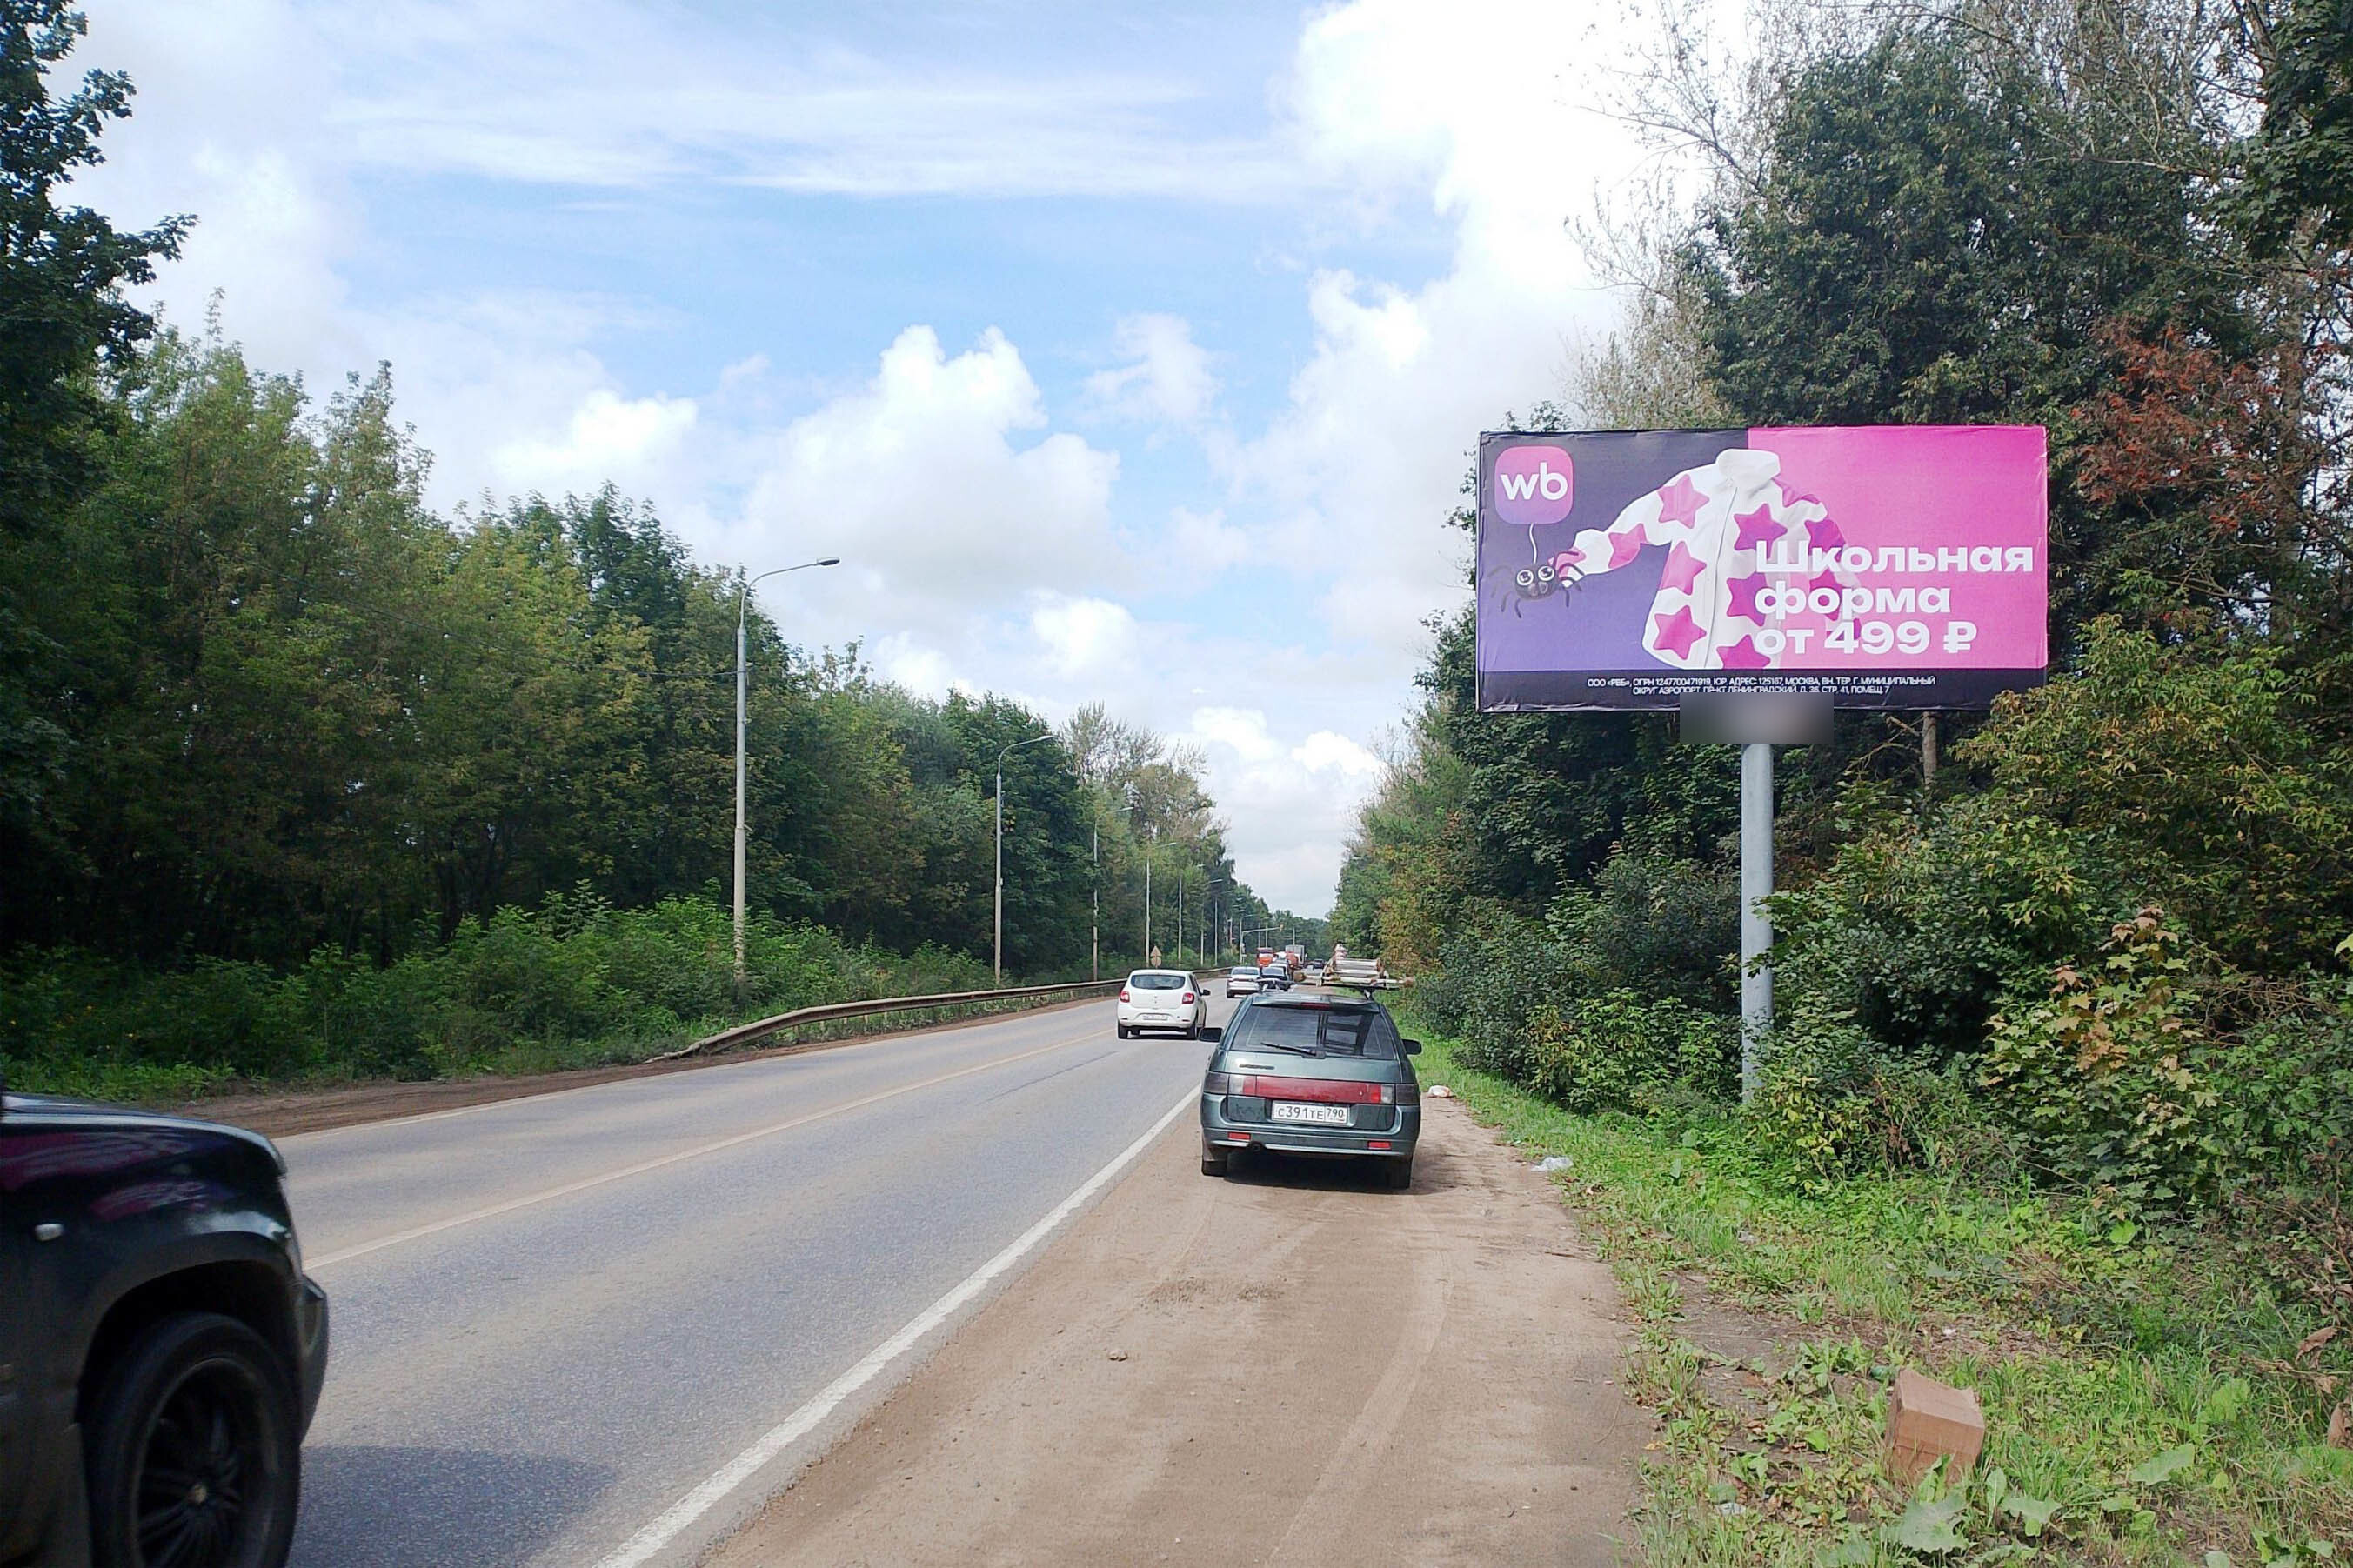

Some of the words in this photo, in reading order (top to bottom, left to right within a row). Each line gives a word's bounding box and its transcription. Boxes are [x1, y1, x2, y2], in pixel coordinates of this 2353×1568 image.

[1501, 462, 1568, 500] wb
[1755, 540, 2033, 572] Школьная
[1755, 580, 1950, 620] форма
[1755, 628, 1814, 654] от
[1824, 620, 1930, 654] 499
[1588, 678, 1606, 687] ООО
[1861, 676, 1935, 685] МУНИЦИПАЛЬНЫЙ
[1633, 686, 1658, 695] ОКРУГ
